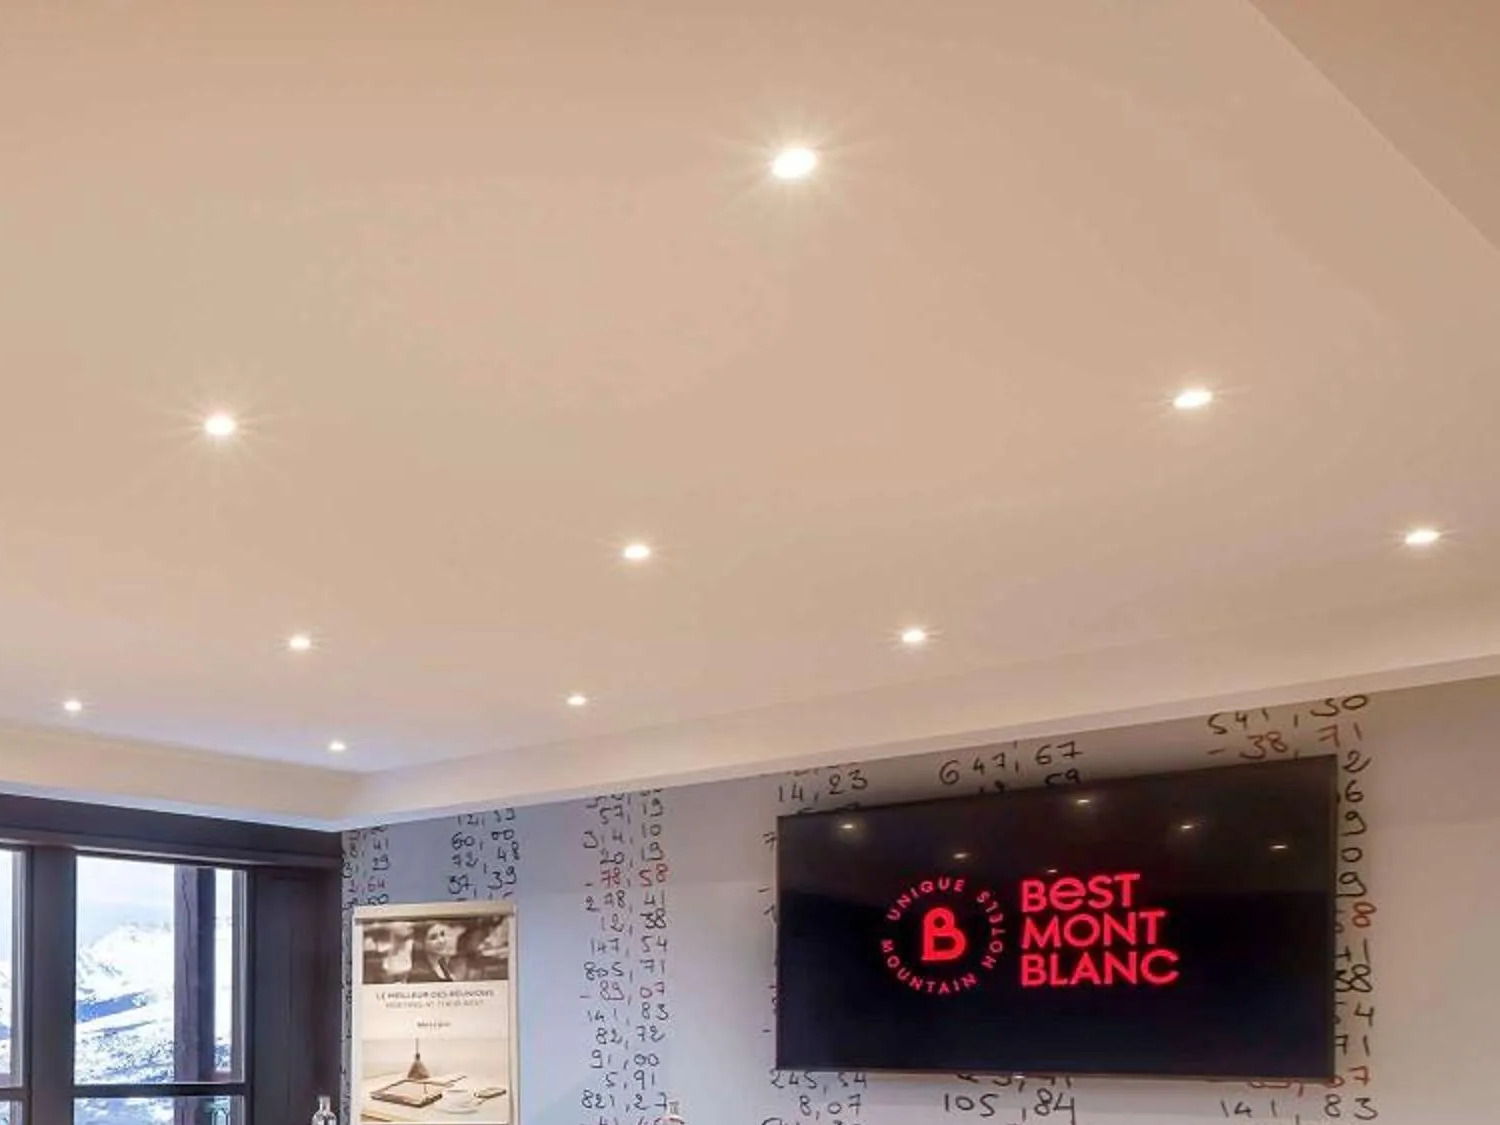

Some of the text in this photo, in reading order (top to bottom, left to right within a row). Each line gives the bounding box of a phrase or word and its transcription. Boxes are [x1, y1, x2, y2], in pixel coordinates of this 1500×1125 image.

[886, 876, 966, 921] UNIQUE
[1021, 910, 1168, 950] MONT
[881, 939, 977, 995] MOUNTAIN
[1021, 949, 1180, 987] BLANC
[799, 1093, 861, 1120] 8,07
[944, 1088, 1077, 1125] 105,84
